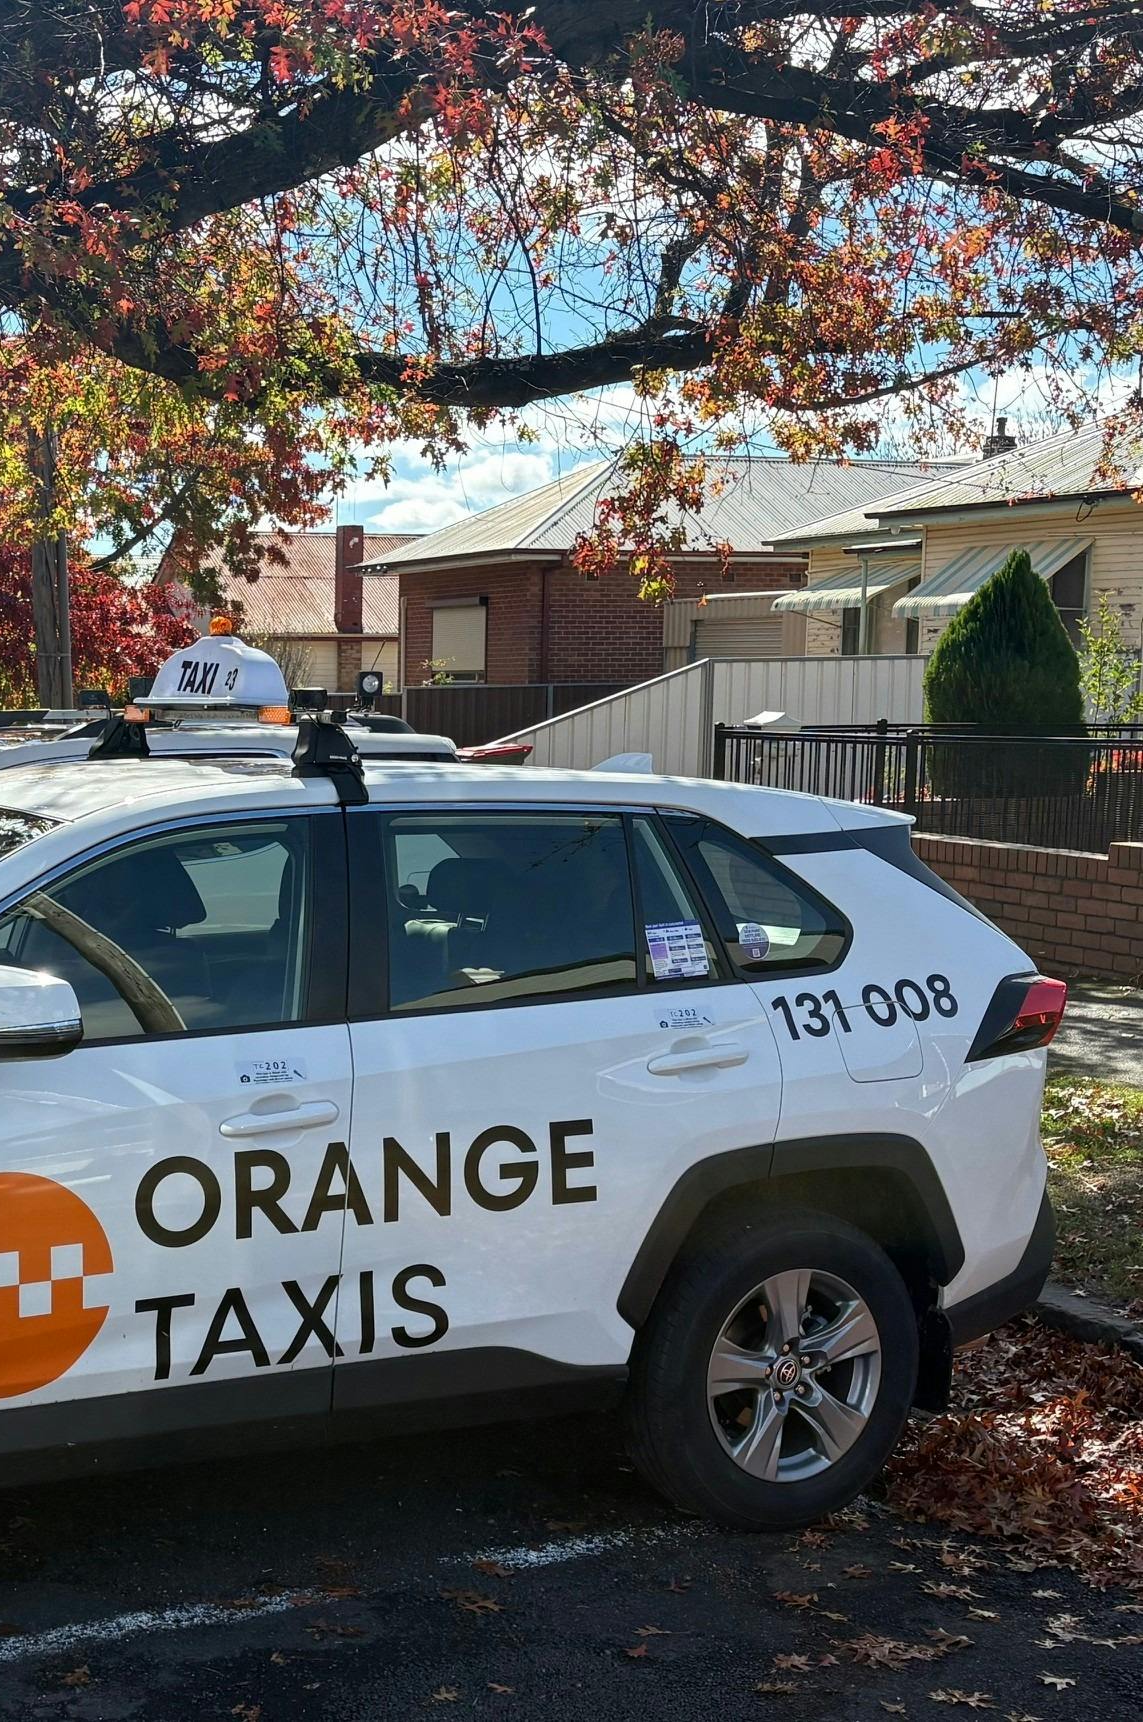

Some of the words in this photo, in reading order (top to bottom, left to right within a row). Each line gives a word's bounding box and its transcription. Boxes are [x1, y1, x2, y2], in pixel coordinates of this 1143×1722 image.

[177, 660, 220, 695] TAXI
[224, 668, 239, 691] 23
[771, 989, 853, 1041] 131
[861, 973, 959, 1028] 008
[133, 1118, 598, 1248] ORANGE
[134, 1263, 450, 1381] TAXIS
